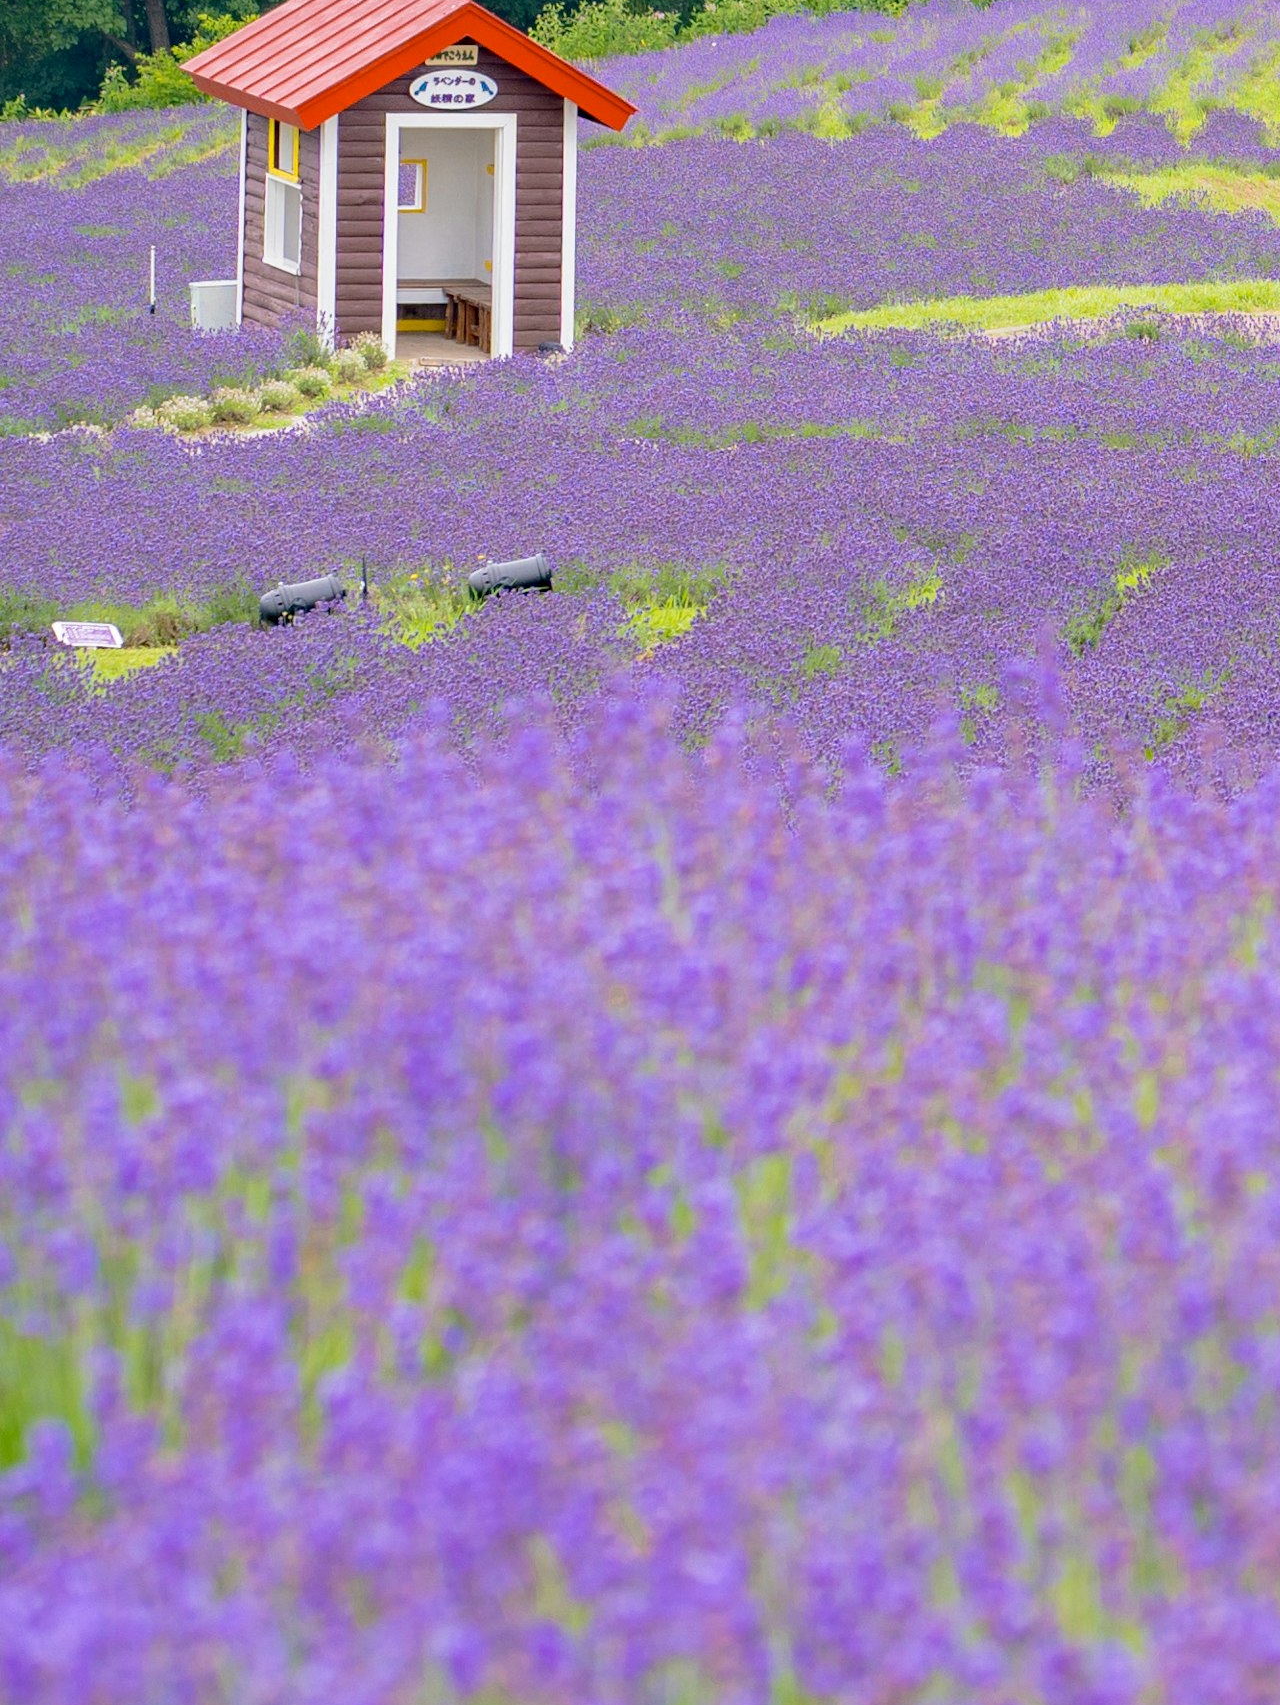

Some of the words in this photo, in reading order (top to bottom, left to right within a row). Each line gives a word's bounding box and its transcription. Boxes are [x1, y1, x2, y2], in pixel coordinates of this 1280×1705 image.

[433, 75, 476, 86] ラベンダーの
